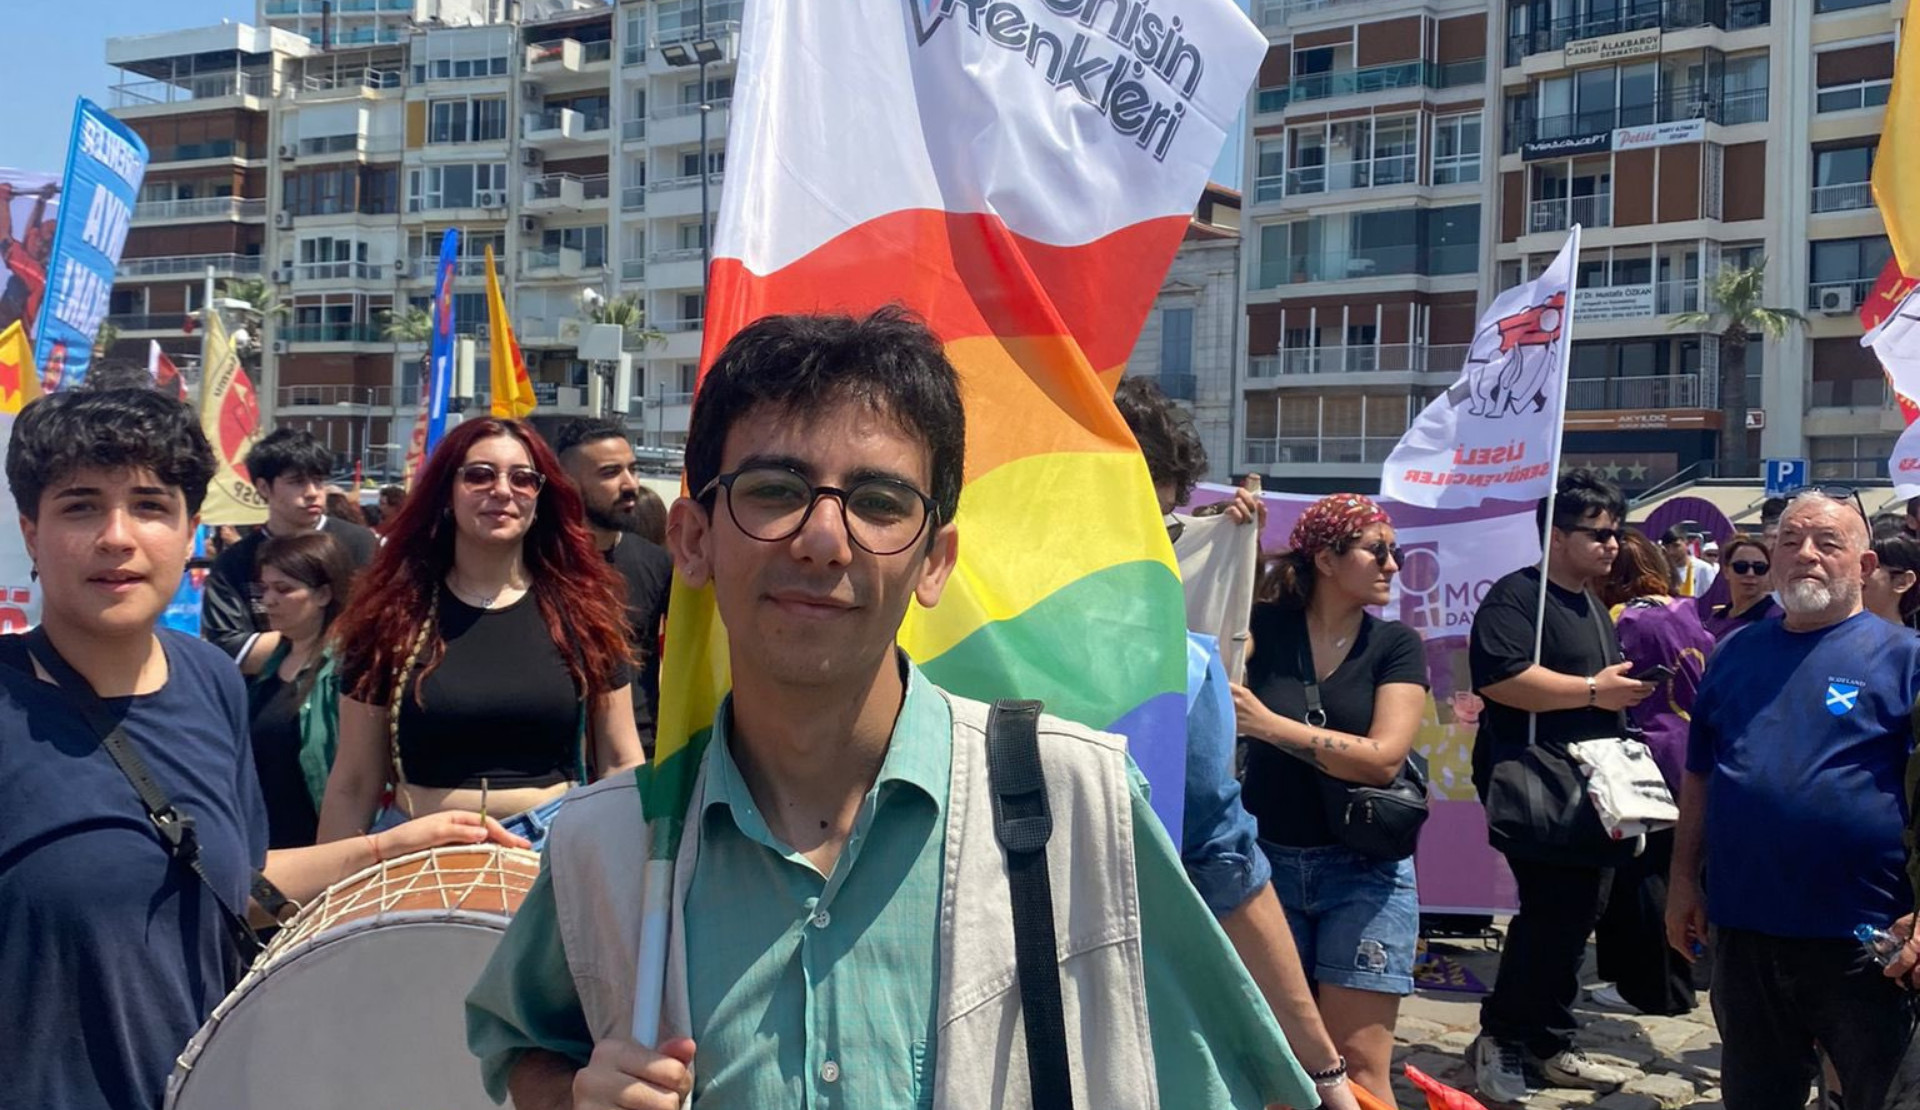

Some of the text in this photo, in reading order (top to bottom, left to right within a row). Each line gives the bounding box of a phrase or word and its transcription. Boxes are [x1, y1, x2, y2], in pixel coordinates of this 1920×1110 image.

[1567, 45, 1598, 56] CANSU
[1601, 36, 1659, 50] ALAKBAROV
[1625, 287, 1651, 297] ÖZKAN
[1777, 461, 1794, 483] P
